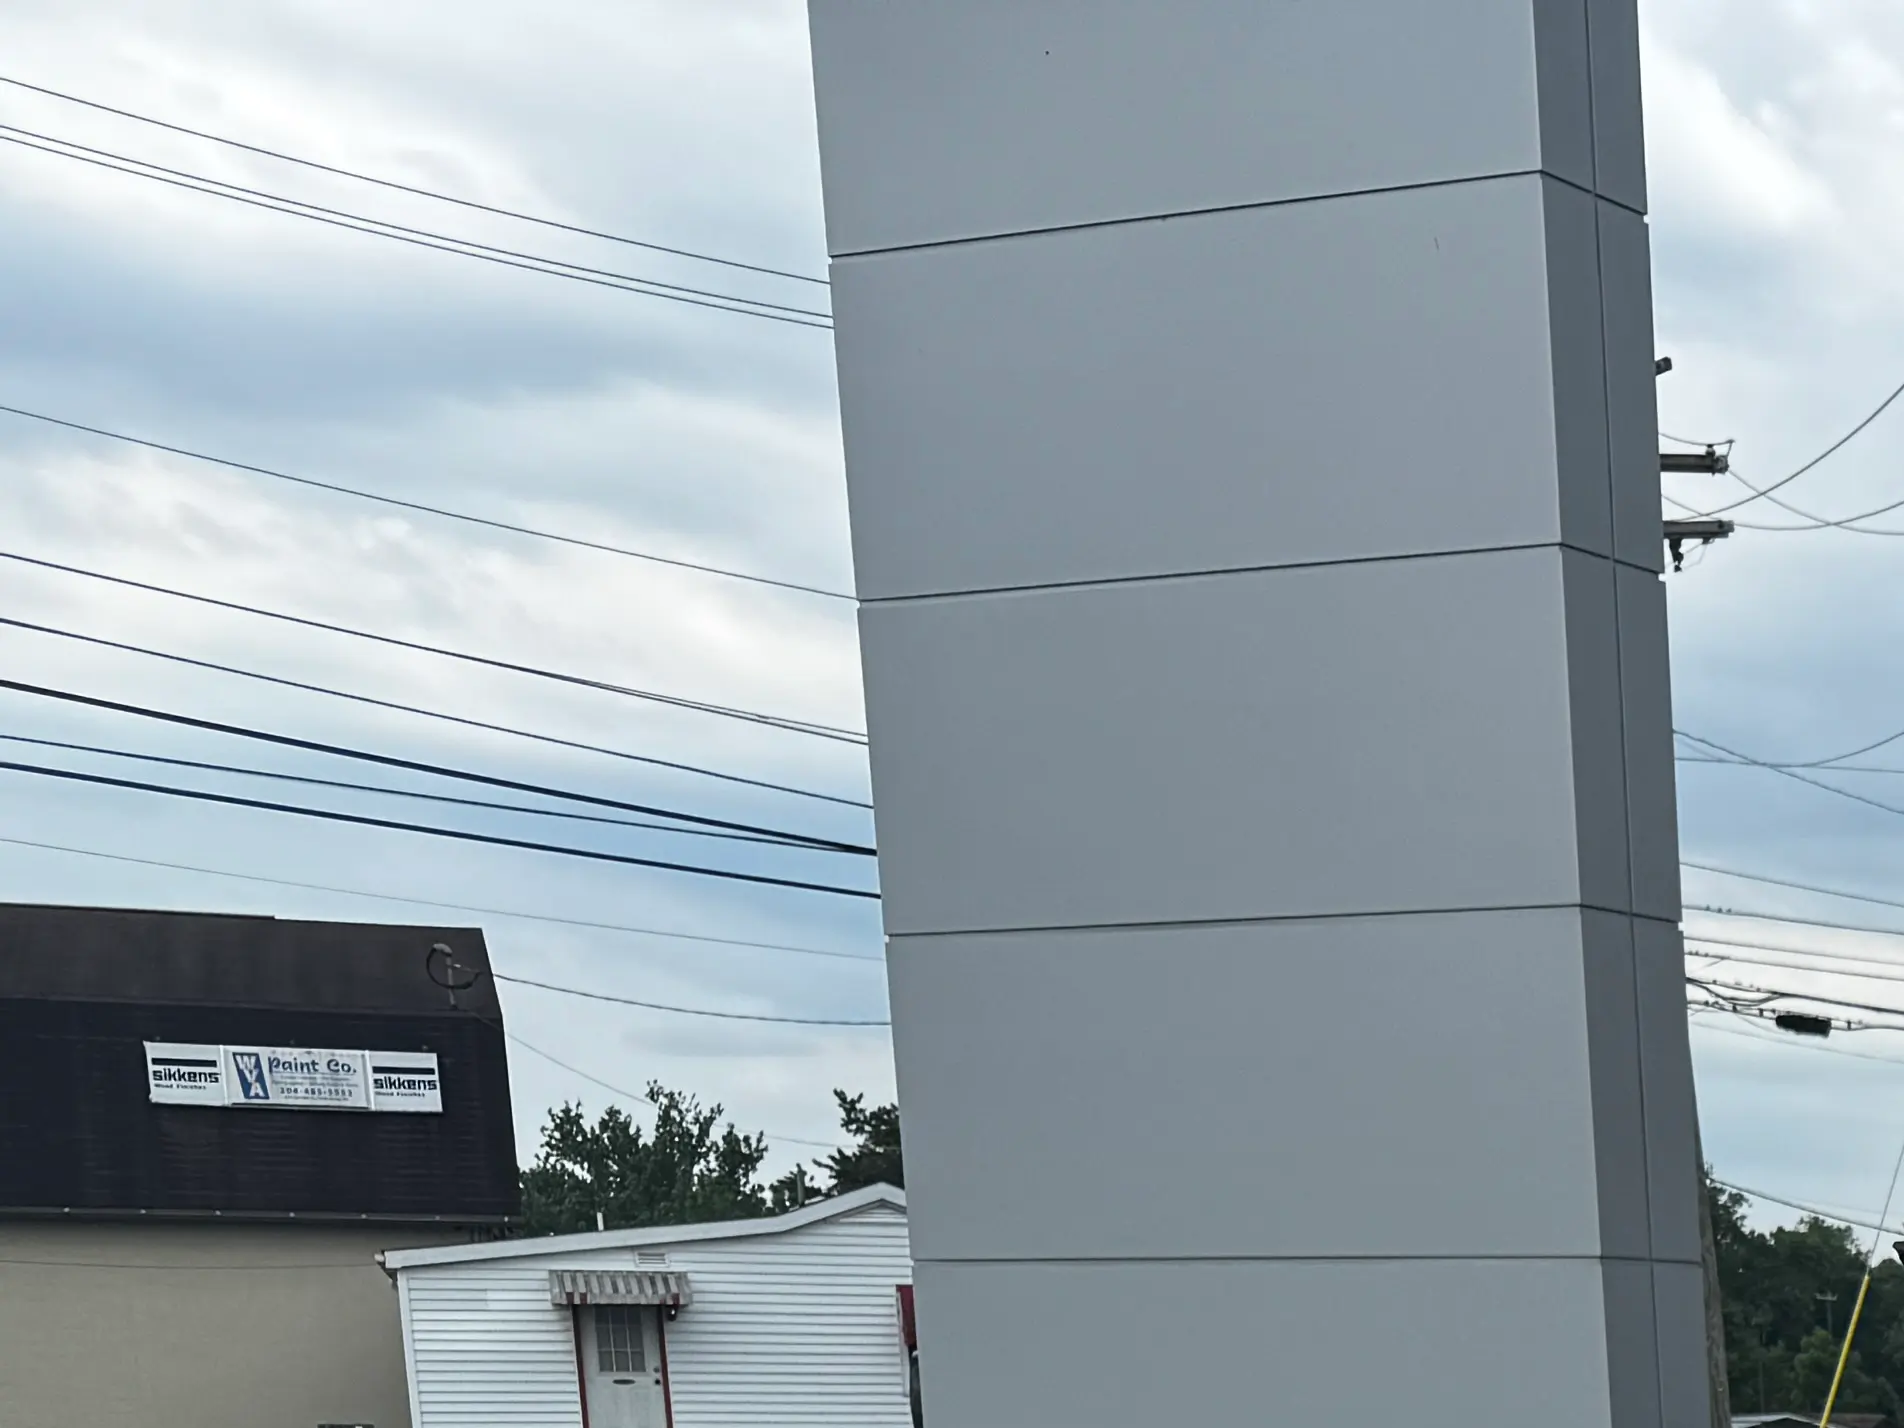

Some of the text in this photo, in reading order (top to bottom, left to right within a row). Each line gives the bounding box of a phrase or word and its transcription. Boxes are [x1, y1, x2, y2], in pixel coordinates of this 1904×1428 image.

[268, 1056, 357, 1076] Paint Co.
[152, 1068, 221, 1084] sikkens
[373, 1076, 437, 1091] sikkens
